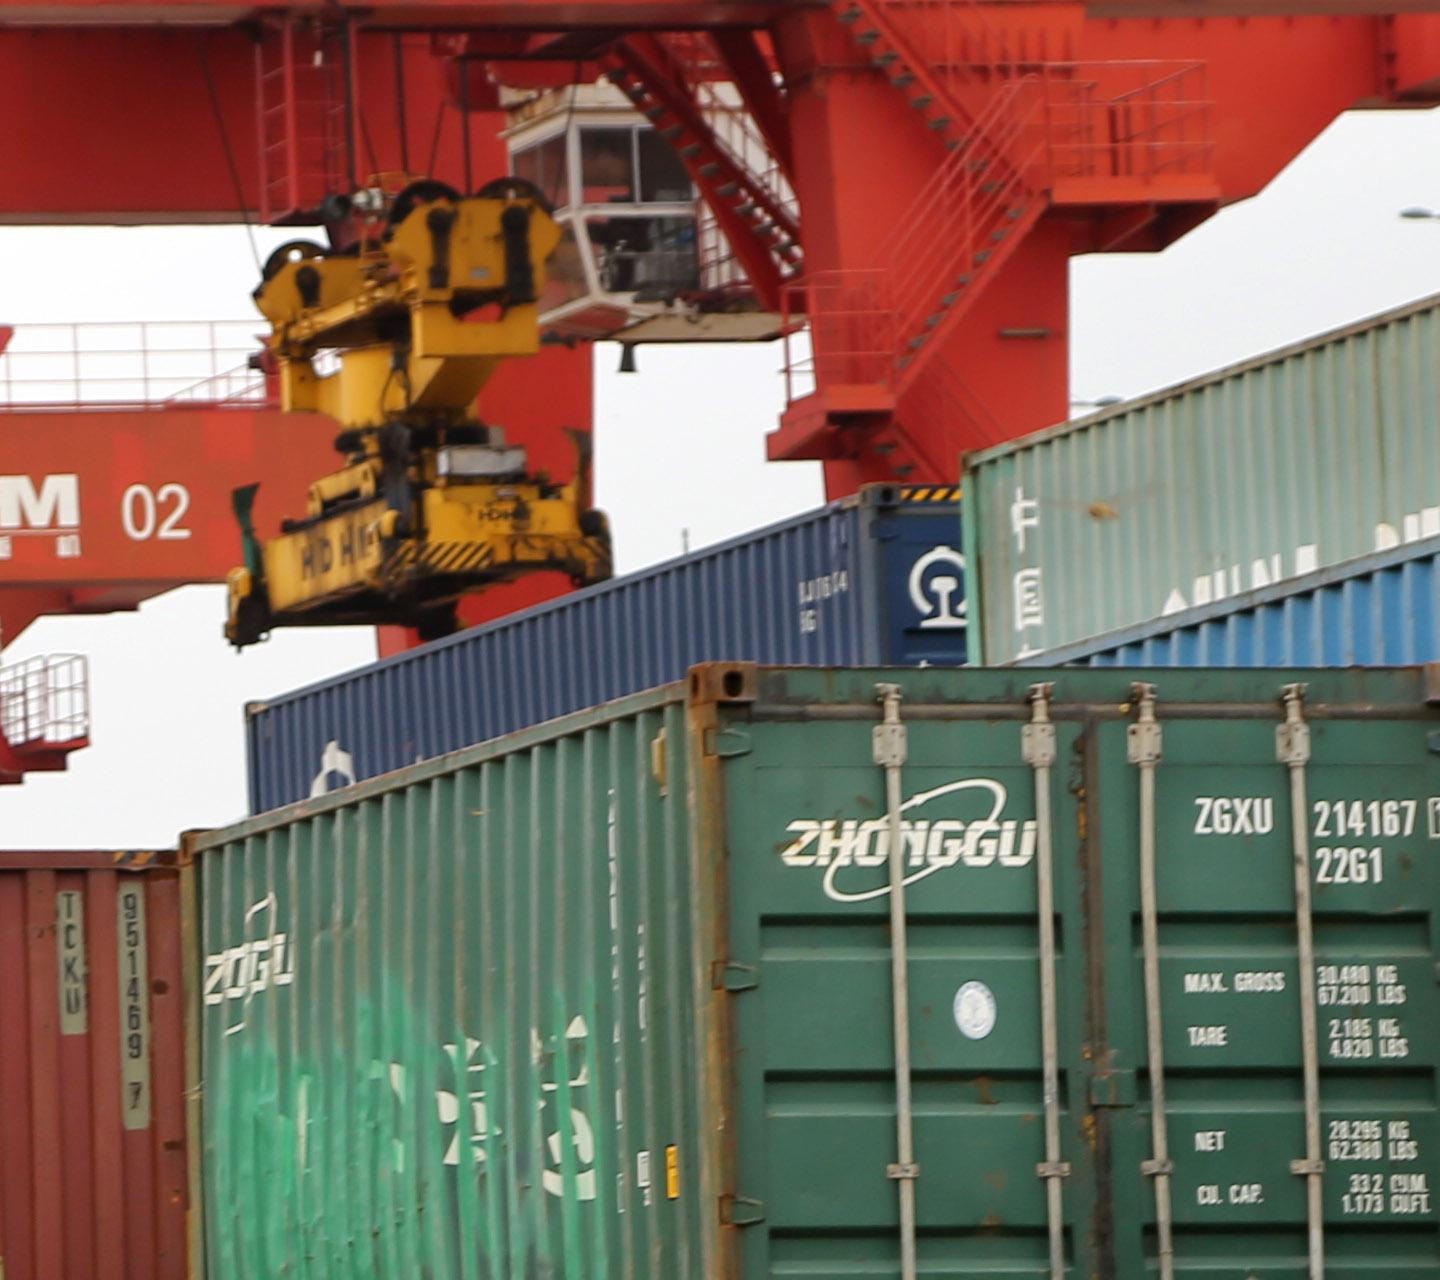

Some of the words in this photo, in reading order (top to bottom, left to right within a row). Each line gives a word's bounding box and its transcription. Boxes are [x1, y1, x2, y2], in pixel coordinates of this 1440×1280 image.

[121, 482, 192, 541] 02
[1194, 797, 1274, 835] ZGXU
[1313, 798, 1417, 838] 214167
[780, 819, 1037, 868] ZHONGGU
[1315, 846, 1383, 884] 22G1
[63, 892, 81, 1015] TCKU
[1234, 972, 1286, 993] GROSS
[1376, 965, 1398, 985] KG
[1377, 985, 1407, 1005] LBS
[1187, 1025, 1229, 1047] TARE
[1378, 1018, 1400, 1037] KG
[1379, 1038, 1409, 1058] LBS
[1194, 1130, 1226, 1152] NET
[1388, 1120, 1410, 1140] KG
[1388, 1140, 1419, 1160] LBS
